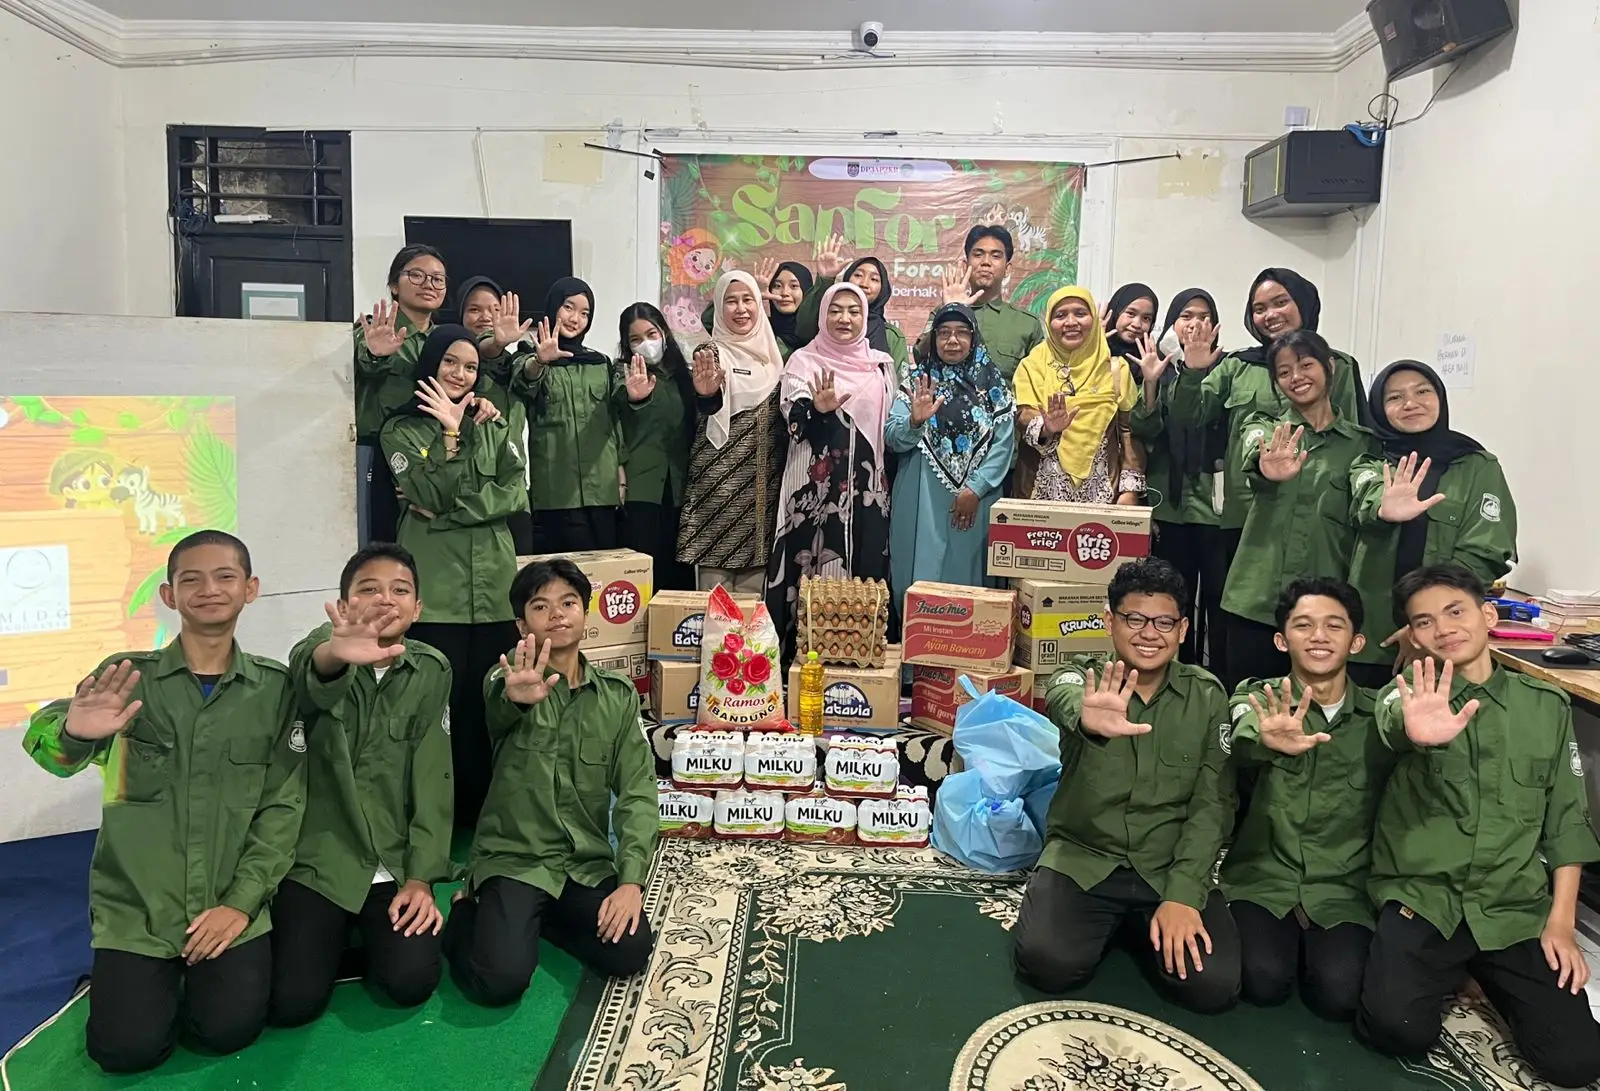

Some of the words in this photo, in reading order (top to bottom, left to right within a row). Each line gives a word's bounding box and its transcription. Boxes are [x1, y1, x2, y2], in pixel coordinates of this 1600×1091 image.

[893, 258, 958, 278] Fora
[891, 285, 937, 298] berhak
[1026, 530, 1063, 541] French
[1030, 537, 1058, 549] Fries
[1076, 533, 1112, 549] Kris
[1000, 545, 1007, 555] 9
[1077, 547, 1111, 562] Bee
[605, 589, 636, 606] Kris
[606, 603, 635, 619] Bee
[933, 626, 954, 635] Instan
[1060, 617, 1104, 634] KRUNCH
[674, 633, 703, 646] Bat
[924, 640, 949, 653] Ayam
[949, 643, 986, 657] Bawang
[1041, 643, 1055, 653] 10
[635, 665, 641, 675] 6
[723, 696, 765, 708] Ramos
[711, 704, 775, 723] BANDUNG
[824, 703, 870, 717] atavia
[686, 758, 732, 772] MILKU
[758, 759, 803, 774] MILKU
[835, 760, 882, 777] MILKU
[727, 806, 773, 822] MILKU
[797, 807, 843, 823] MILKU
[872, 812, 918, 828] MILKU
